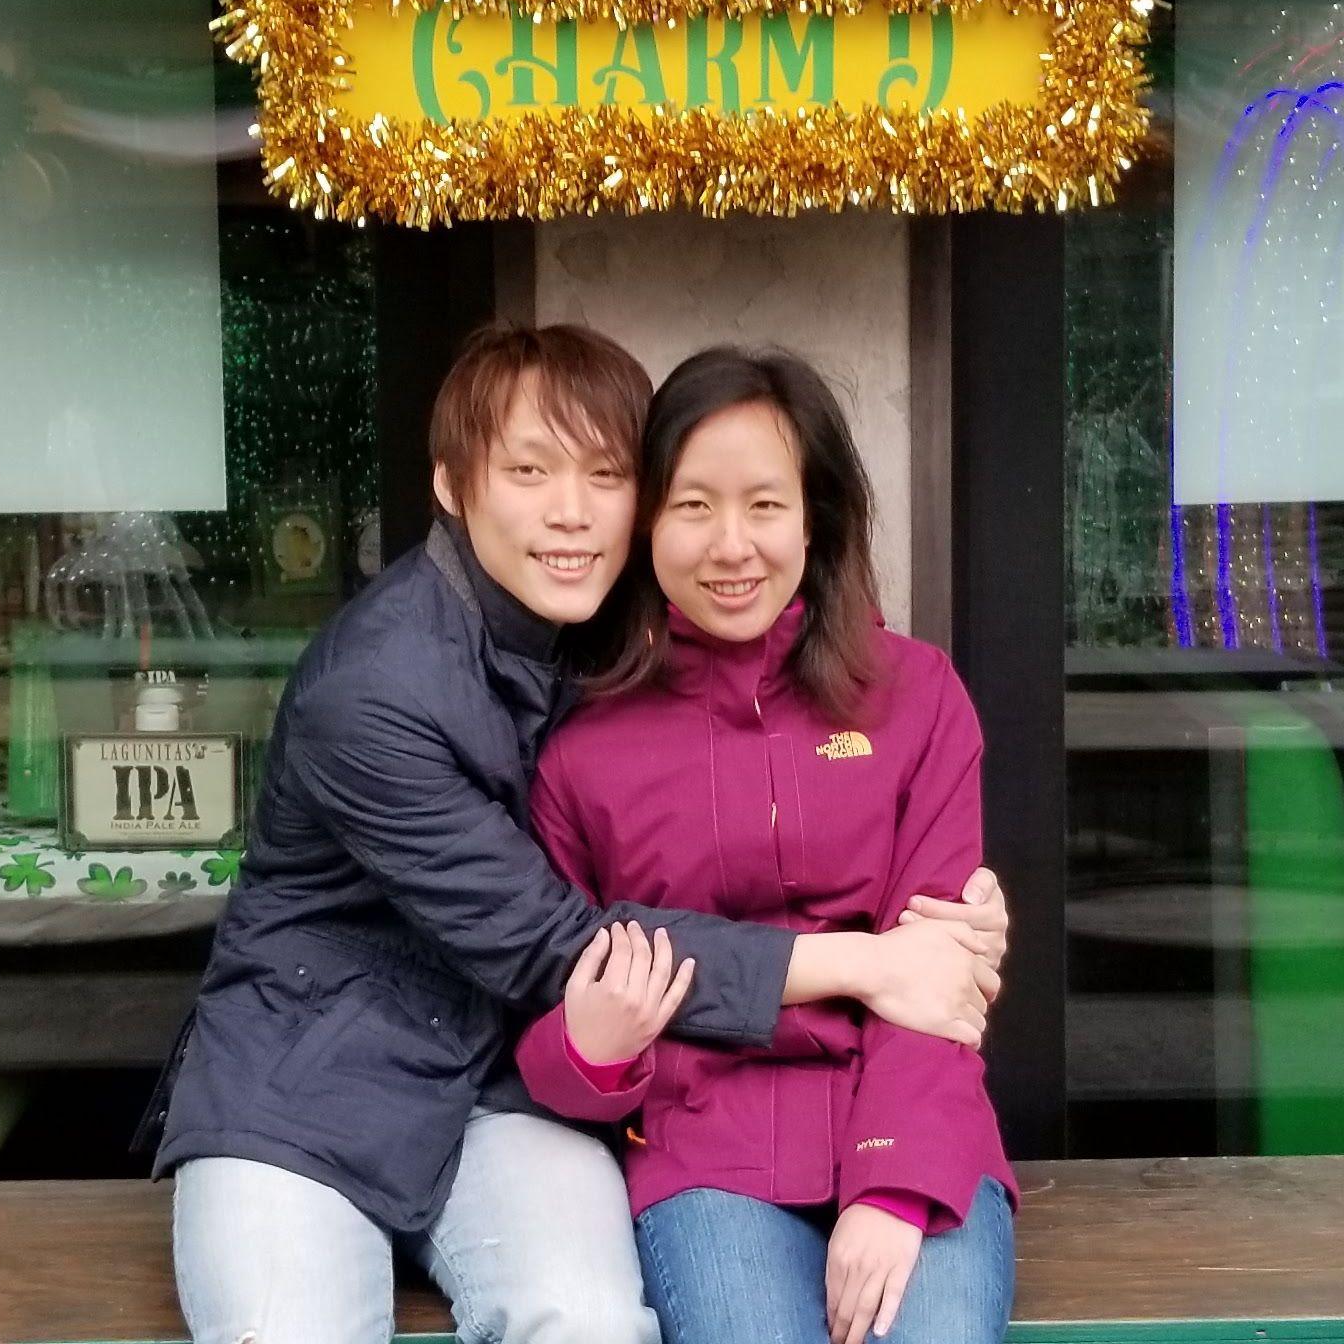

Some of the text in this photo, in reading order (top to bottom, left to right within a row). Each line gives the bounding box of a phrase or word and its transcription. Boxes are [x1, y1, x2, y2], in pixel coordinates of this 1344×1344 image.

[828, 730, 852, 744] THE
[100, 742, 192, 762] LAGUNITAS
[815, 740, 853, 756] NORTH
[112, 765, 201, 821] IPA
[110, 820, 201, 830] INDIA PALE ALE
